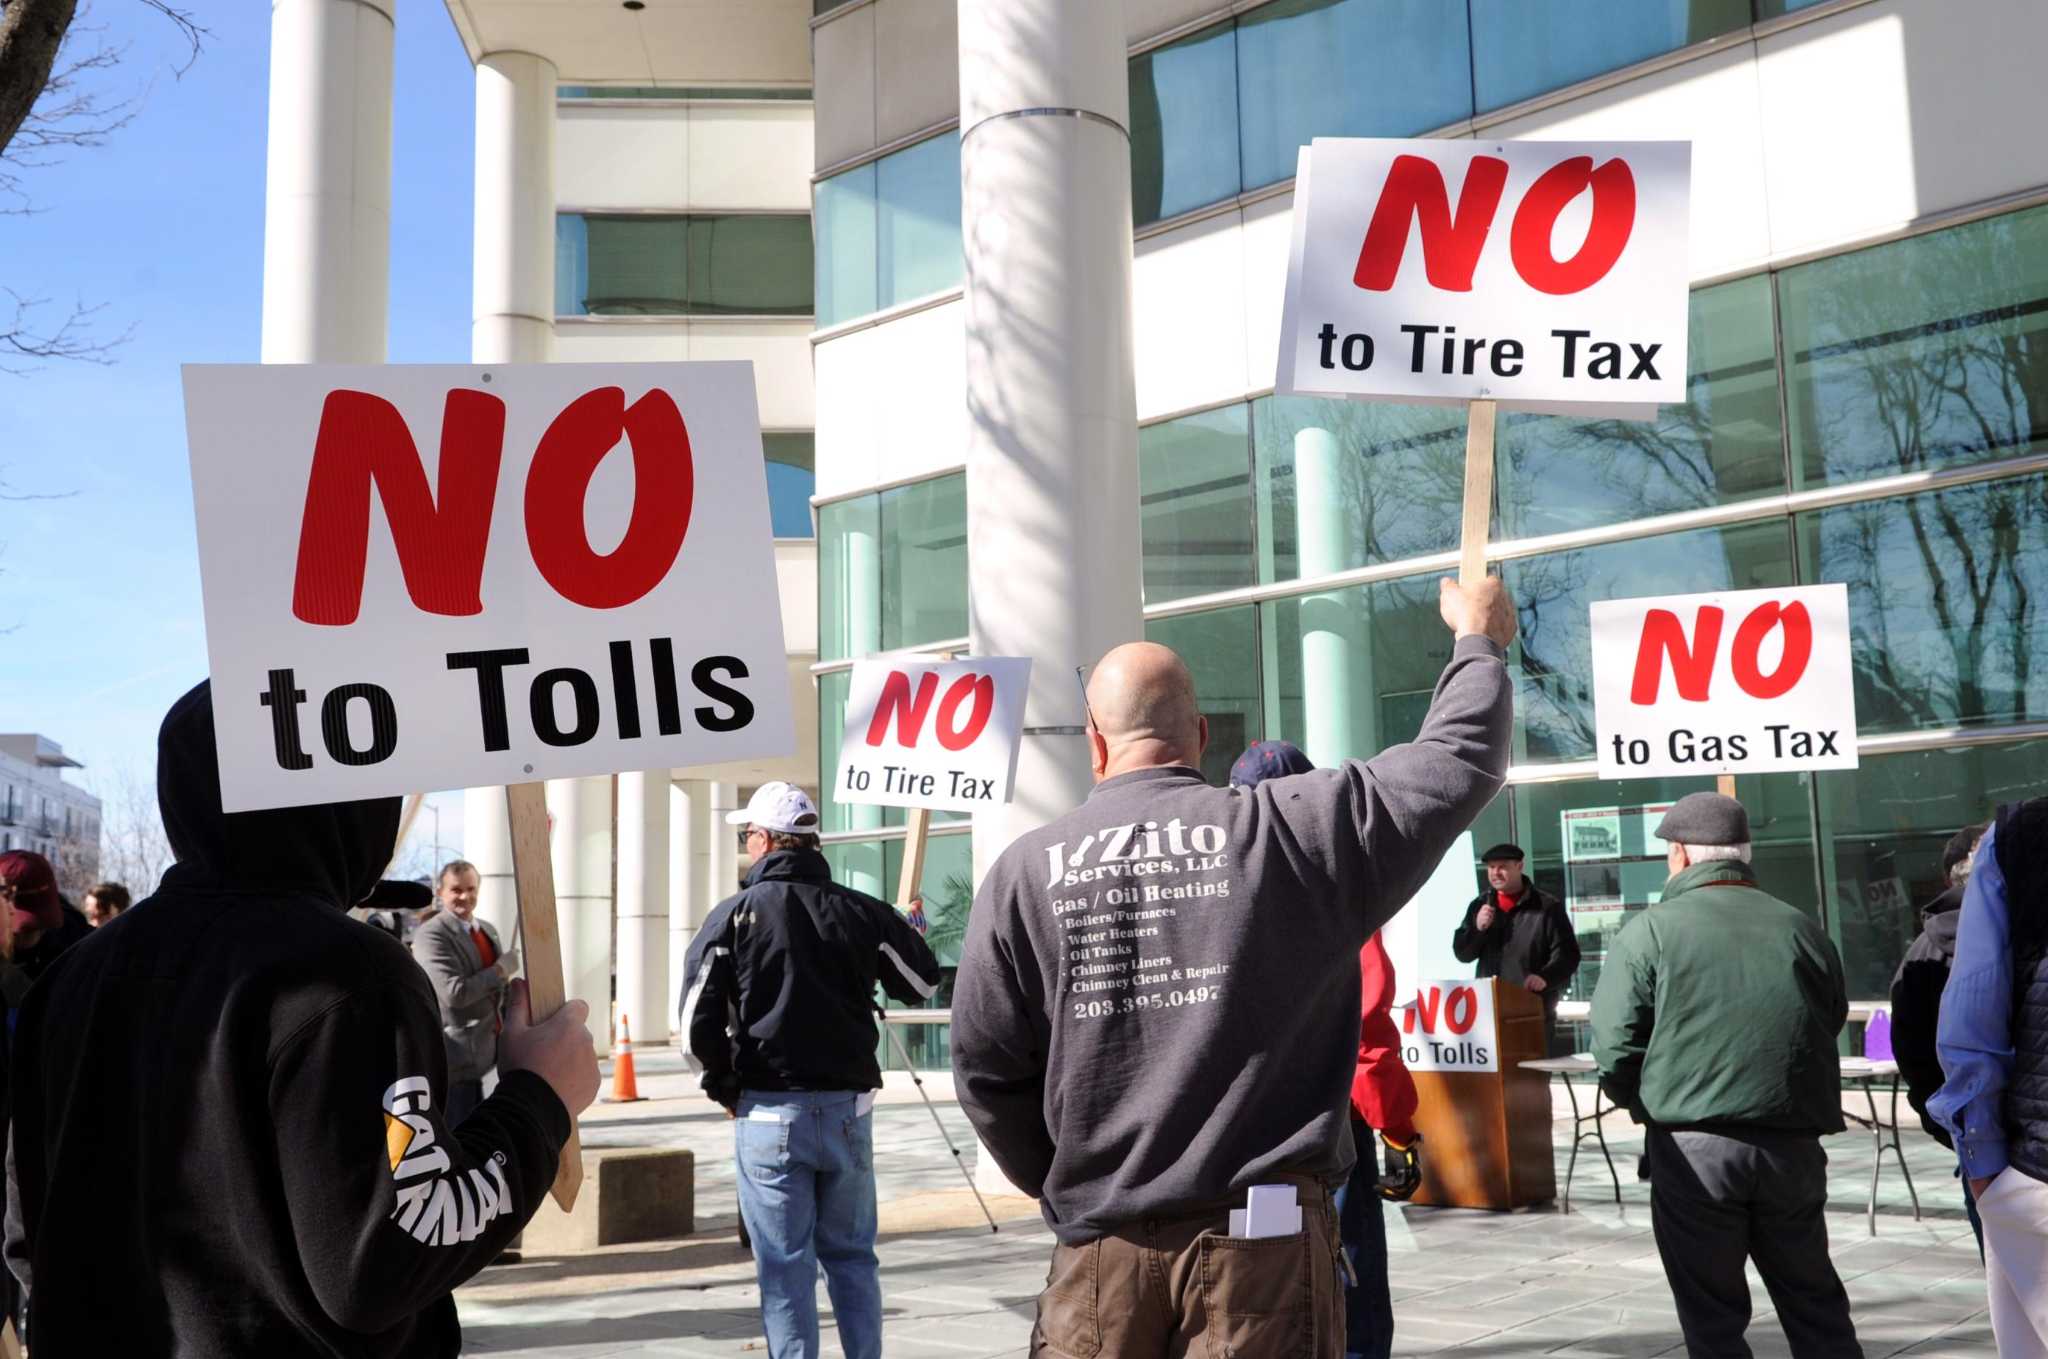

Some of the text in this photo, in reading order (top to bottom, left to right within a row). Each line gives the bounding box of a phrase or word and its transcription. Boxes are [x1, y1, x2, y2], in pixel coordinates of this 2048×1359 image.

[1353, 154, 1637, 296] NO
[1317, 323, 1663, 381] to Tire Tax
[292, 385, 694, 627] NO
[1630, 599, 1814, 707] NO
[259, 637, 756, 771] to Tolls
[866, 671, 994, 752] NO
[1612, 725, 1840, 766] to Gas Tax
[847, 765, 995, 800] to Tire Tax
[1099, 817, 1227, 863] Zito
[1185, 854, 1229, 872] LLC
[1052, 897, 1088, 916] Gas
[1106, 886, 1140, 905] Oil
[1144, 879, 1230, 903] Heating
[1065, 906, 1177, 930] Boilers/Furnaces
[1068, 925, 1159, 946] Water Heaters
[1070, 944, 1133, 962] Oil Tanks
[1071, 955, 1173, 977] Chimney Liners
[1072, 963, 1230, 994] Chimney Clean & Repair
[1403, 985, 1478, 1036] NO
[1429, 1042, 1489, 1065] Tolls
